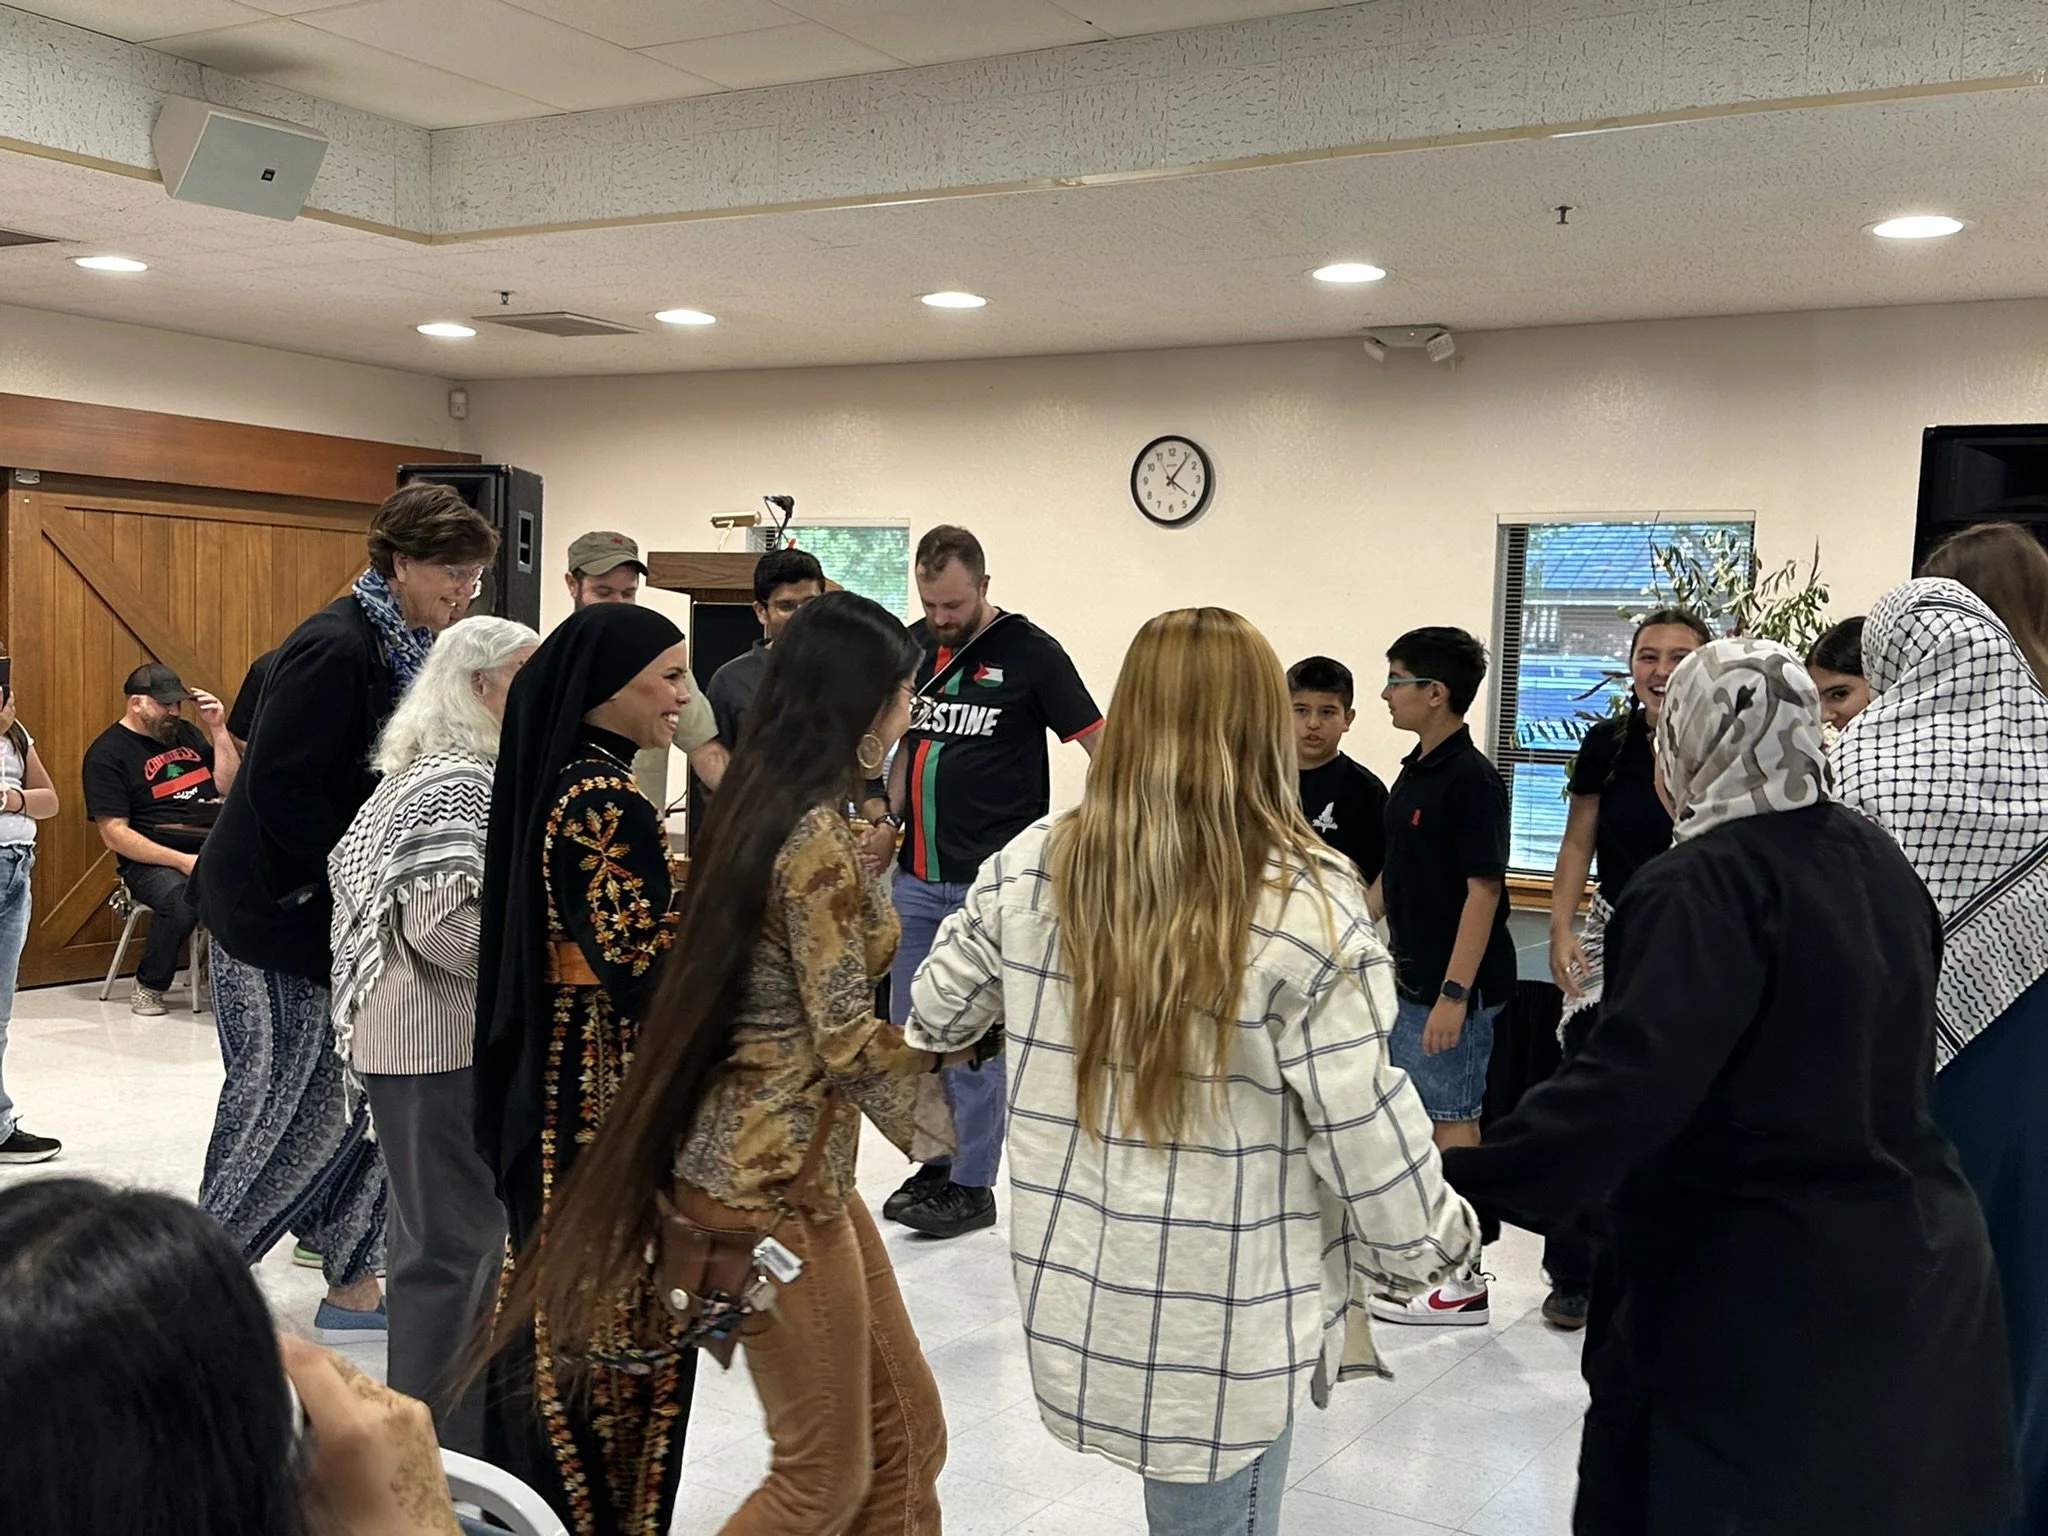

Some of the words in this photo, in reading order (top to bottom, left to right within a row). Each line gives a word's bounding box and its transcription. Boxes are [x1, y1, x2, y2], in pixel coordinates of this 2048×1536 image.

[1156, 452, 1163, 461] 11
[1168, 447, 1176, 457] 12
[1147, 463, 1155, 472] 10
[1191, 461, 1197, 471] 2
[1143, 476, 1149, 485] 9
[1196, 474, 1201, 484] 3
[1147, 491, 1152, 500] 8
[1191, 490, 1196, 498] 4
[1156, 500, 1161, 509] 7
[1168, 504, 1174, 513] 6
[1182, 499, 1187, 509] 5
